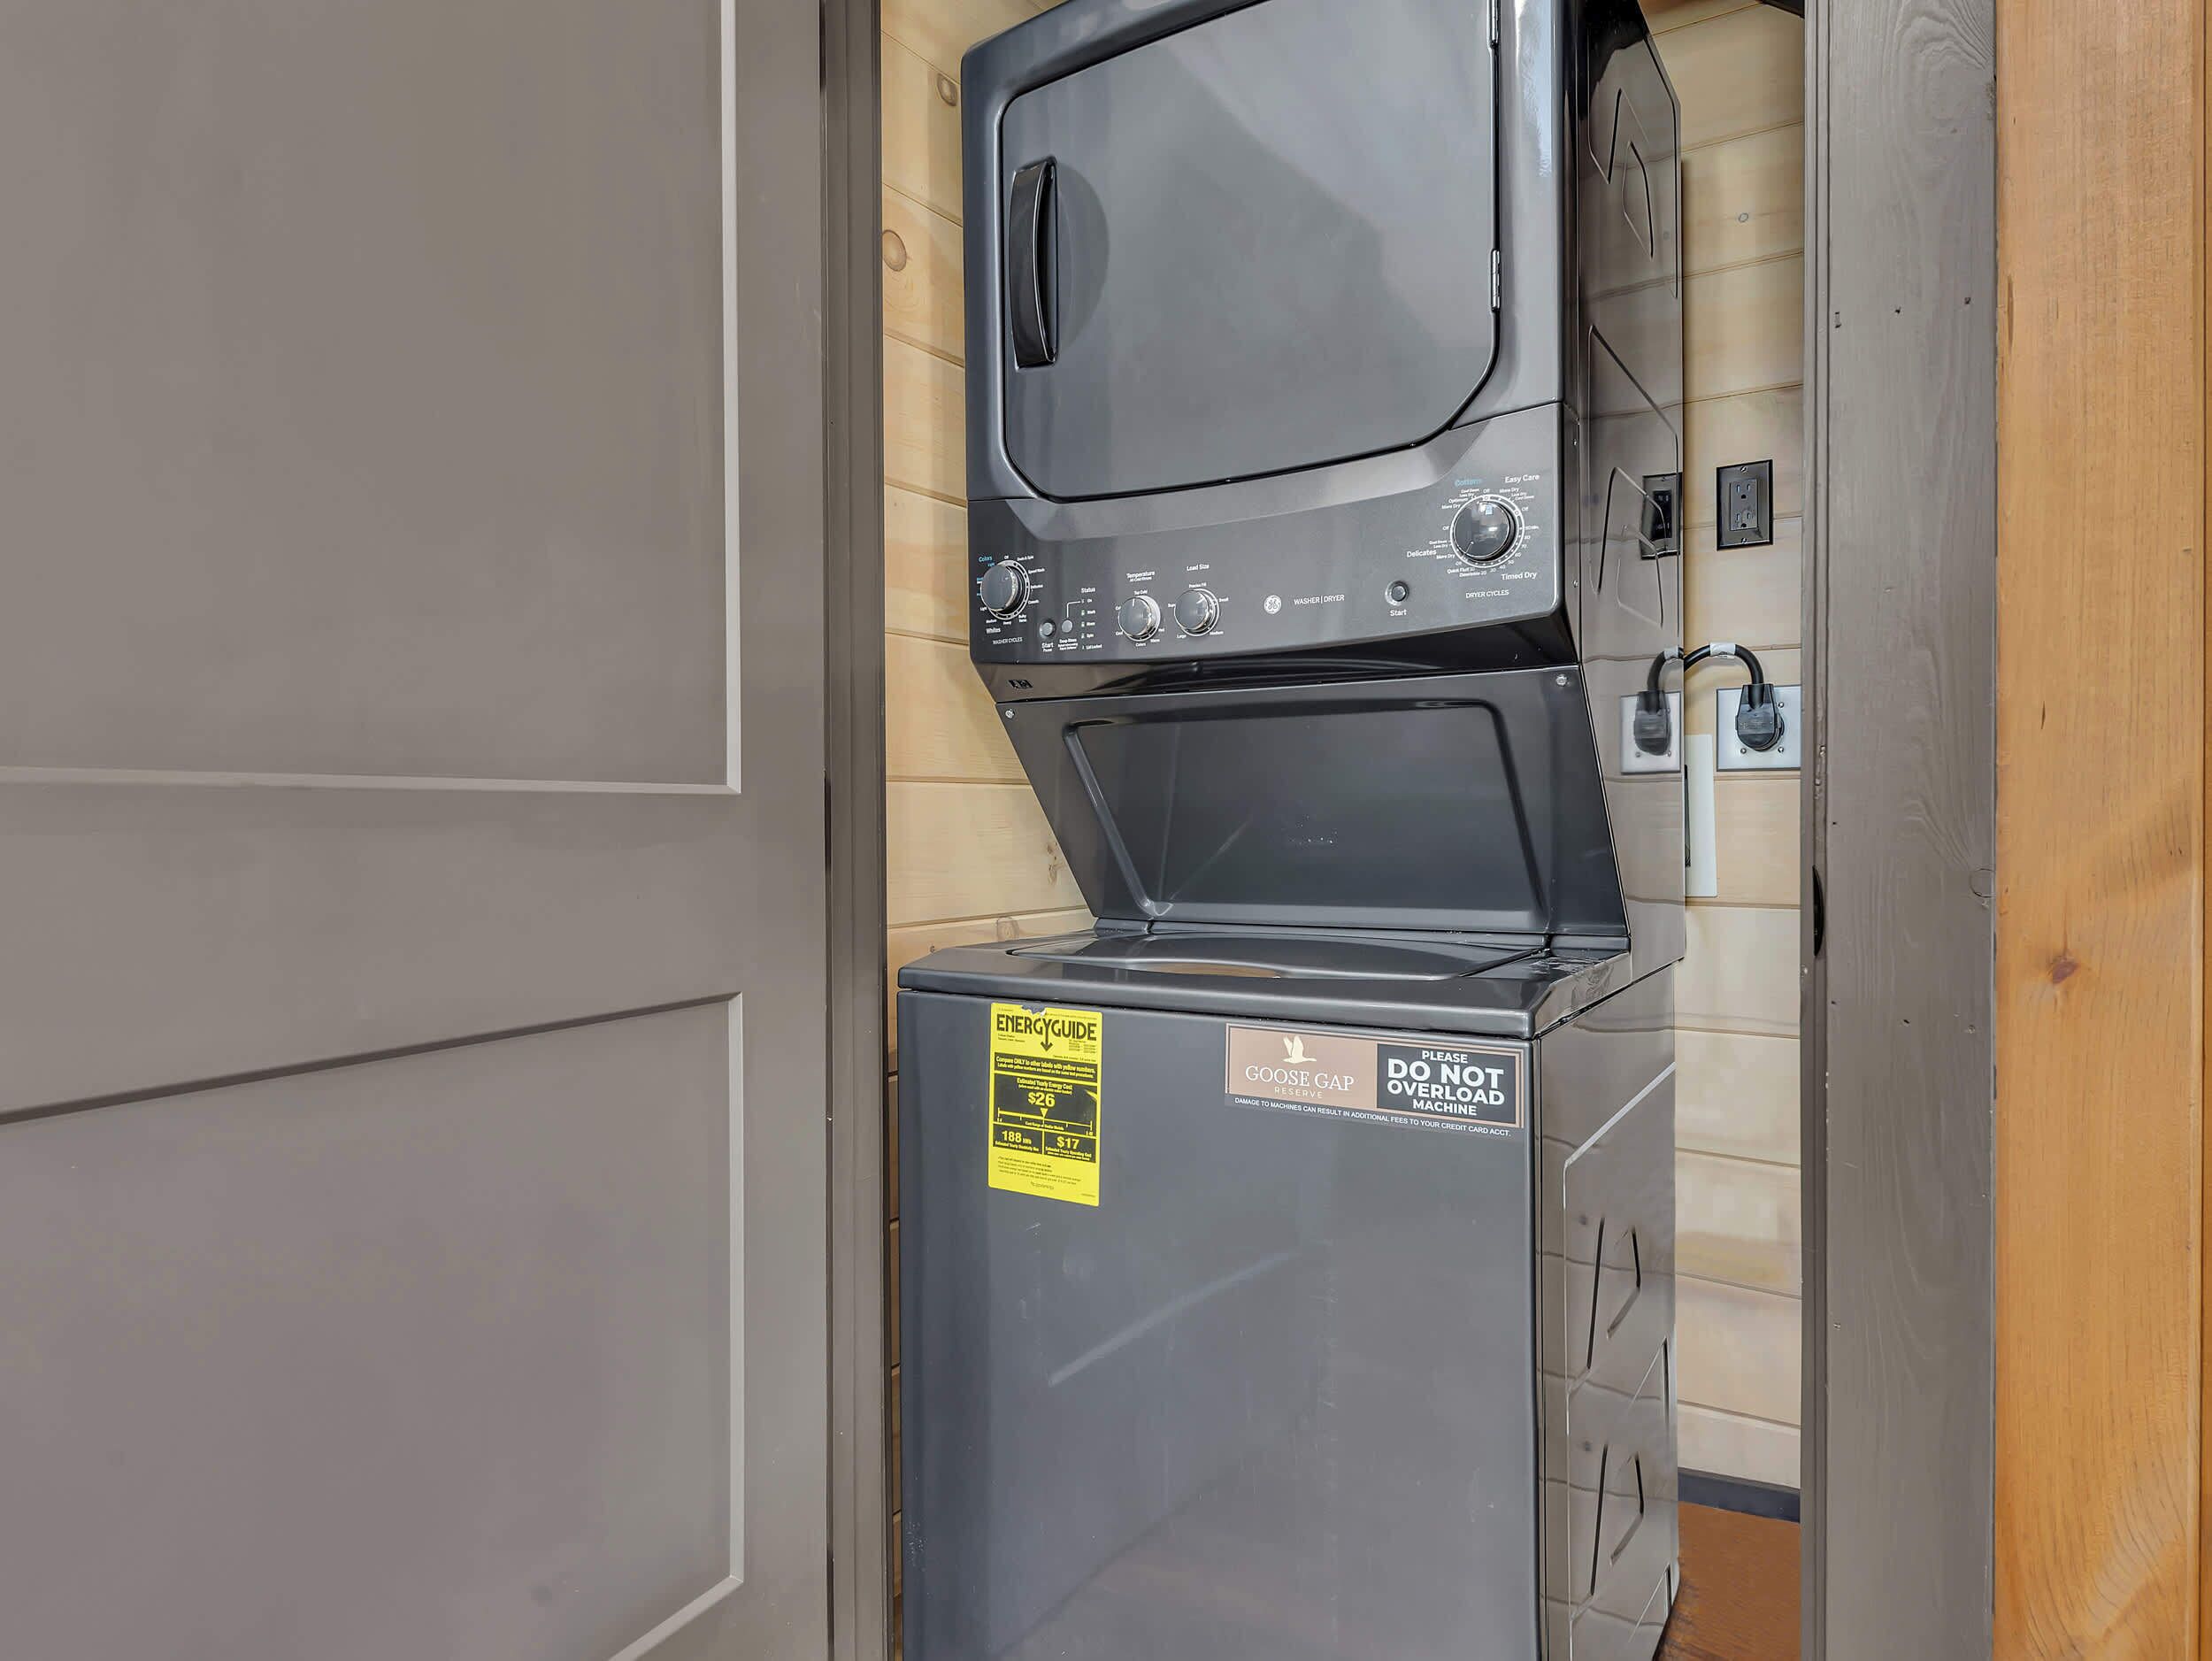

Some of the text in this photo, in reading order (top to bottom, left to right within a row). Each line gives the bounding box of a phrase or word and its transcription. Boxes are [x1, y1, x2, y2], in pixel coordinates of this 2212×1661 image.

[997, 1013, 1097, 1042] ENERGYGUIDE
[1422, 1050, 1468, 1064] PLEASE
[1245, 1065, 1354, 1091] GOOSE GAP
[1387, 1058, 1504, 1089] DO NOT
[1048, 1080, 1063, 1089] Energy
[1028, 1092, 1056, 1107] $26
[1274, 1087, 1323, 1099] RESERVE
[1387, 1080, 1504, 1105] OVERLOAD
[1234, 1097, 1260, 1106] DAMAGE
[1271, 1102, 1302, 1111] MACHINES
[1317, 1107, 1341, 1116] RESULT
[1351, 1112, 1389, 1122] ADDITIONAL
[1441, 1122, 1467, 1131] CREDIT
[1412, 1099, 1478, 1115] MACHINE
[1002, 1130, 1022, 1142] 188
[1056, 1136, 1079, 1150] $17
